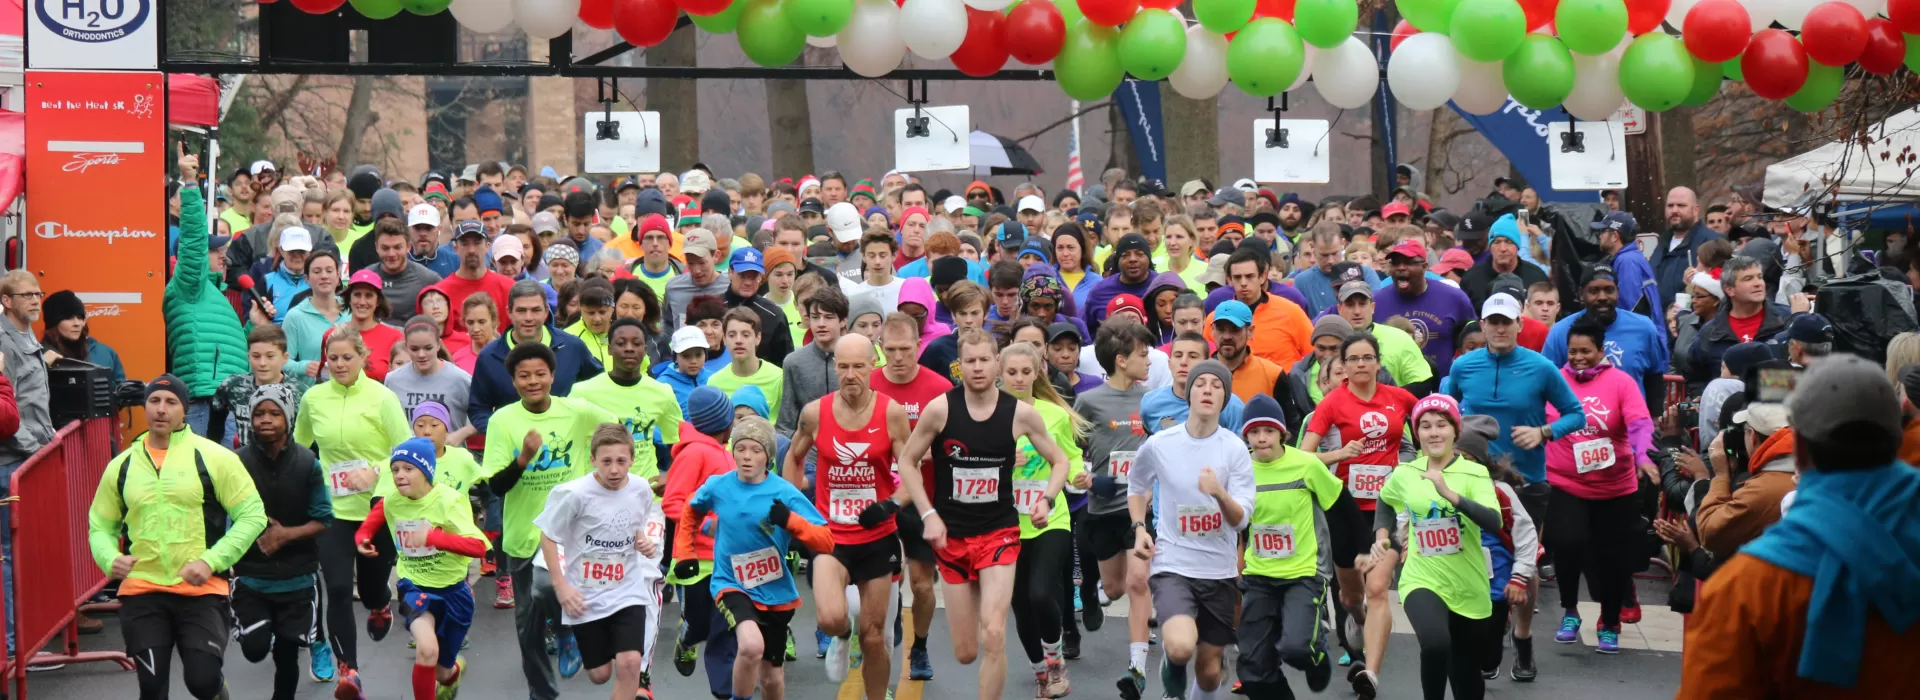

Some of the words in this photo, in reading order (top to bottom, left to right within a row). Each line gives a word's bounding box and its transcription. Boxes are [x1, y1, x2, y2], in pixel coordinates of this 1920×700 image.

[62, 28, 125, 41] ORTHODONTICS
[41, 100, 62, 109] Beat
[66, 100, 82, 109] the
[85, 100, 109, 110] Heat
[62, 152, 127, 174] Sports
[35, 221, 157, 245] Champion
[83, 304, 129, 319] ports
[1412, 310, 1443, 326] FITNESS
[406, 392, 445, 406] TEAM
[1412, 399, 1451, 413] MEOW
[1581, 446, 1610, 466] 646
[828, 465, 875, 477] ATLANTA
[1111, 460, 1130, 476] 14
[330, 471, 351, 489] 13
[856, 474, 876, 482] CLUB
[955, 478, 998, 496] 1720
[1354, 474, 1386, 492] 588
[1014, 488, 1045, 506] 117
[1179, 511, 1223, 533] 1569
[585, 534, 625, 549] Precious
[1253, 532, 1293, 551] 1051
[1416, 527, 1460, 549] 1003
[583, 561, 625, 581] 1649
[735, 555, 780, 583] 1250
